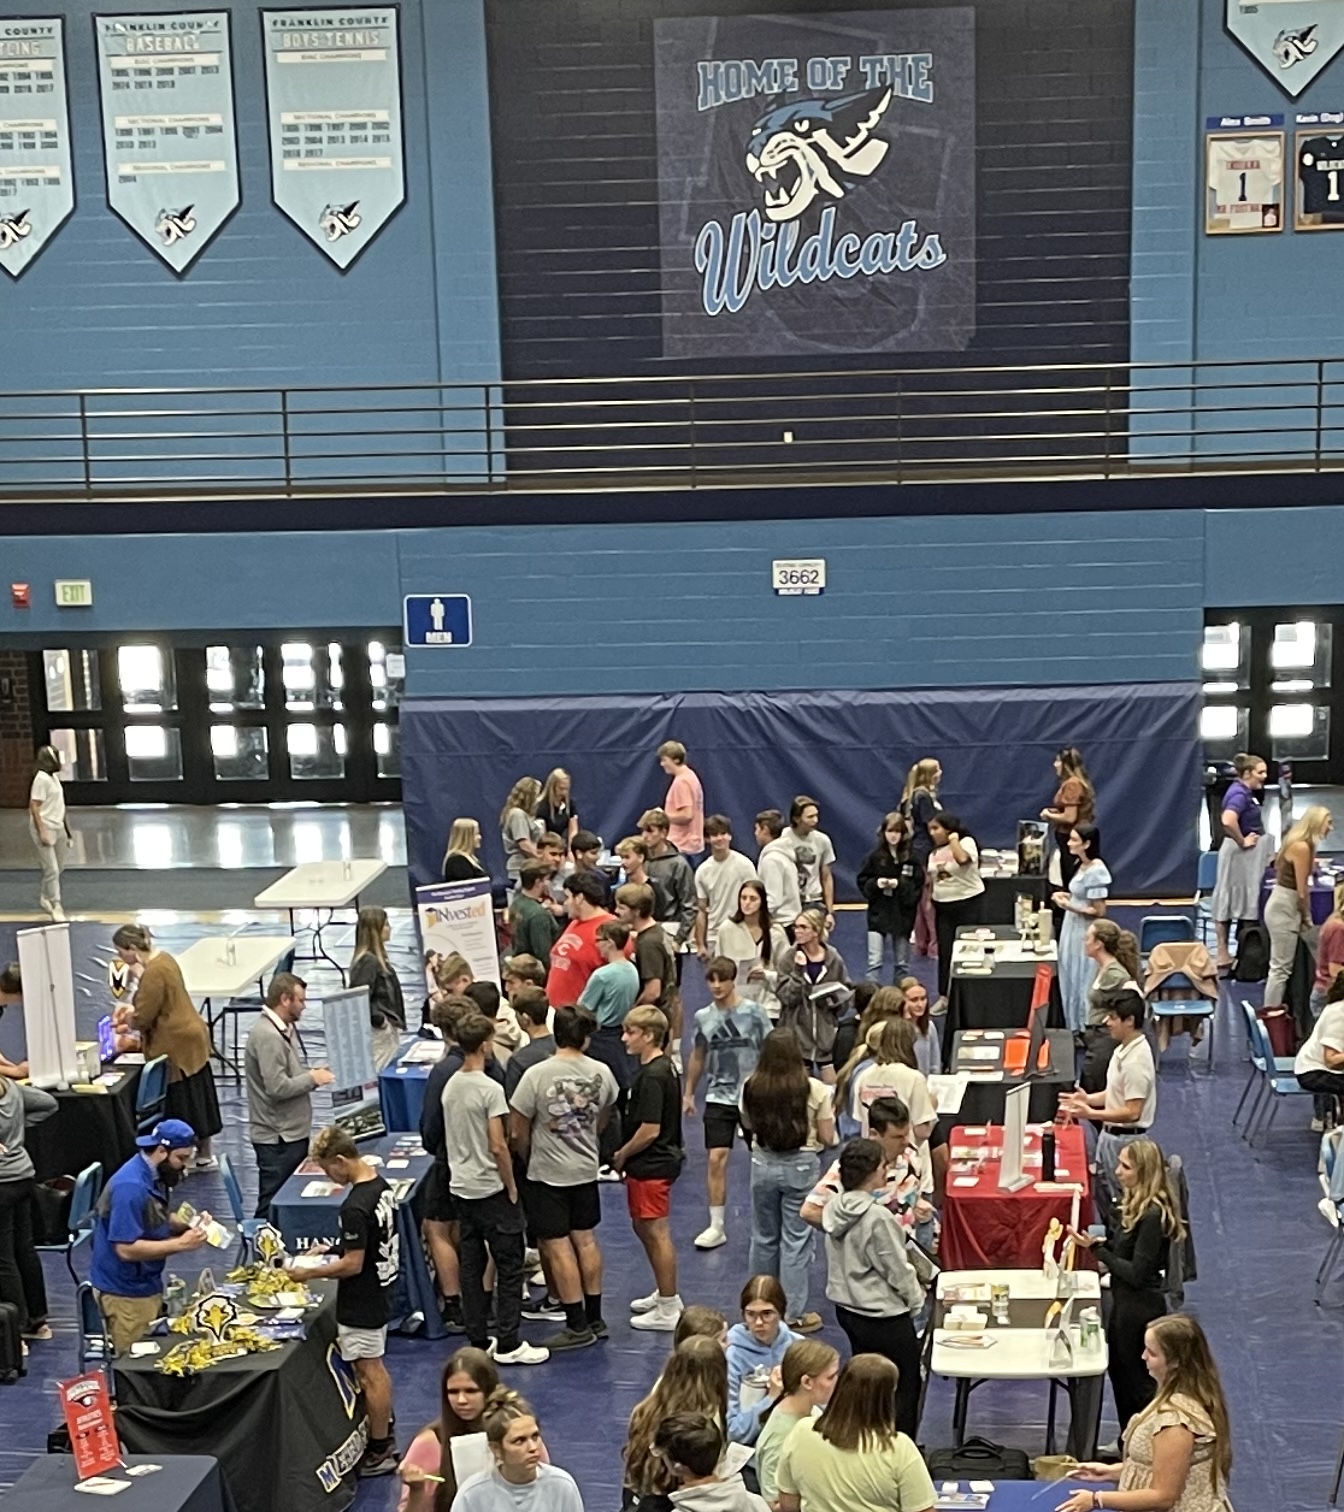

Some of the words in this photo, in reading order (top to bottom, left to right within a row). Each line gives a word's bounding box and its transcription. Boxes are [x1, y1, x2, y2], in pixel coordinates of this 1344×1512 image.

[5, 25, 53, 36] COUNTY
[272, 17, 333, 28] FRANKLIN
[338, 16, 388, 26] COUNTY
[126, 35, 200, 53] BASEBALL
[282, 33, 320, 48] BOYS
[327, 30, 380, 46] TENNIS
[696, 59, 798, 112] HOME
[806, 57, 852, 90] OF
[859, 53, 934, 103] THE
[1238, 172, 1248, 202] 1
[1327, 171, 1340, 201] 1
[694, 206, 947, 316] Wildcats
[779, 569, 819, 584] 3662
[425, 631, 453, 644] MEN
